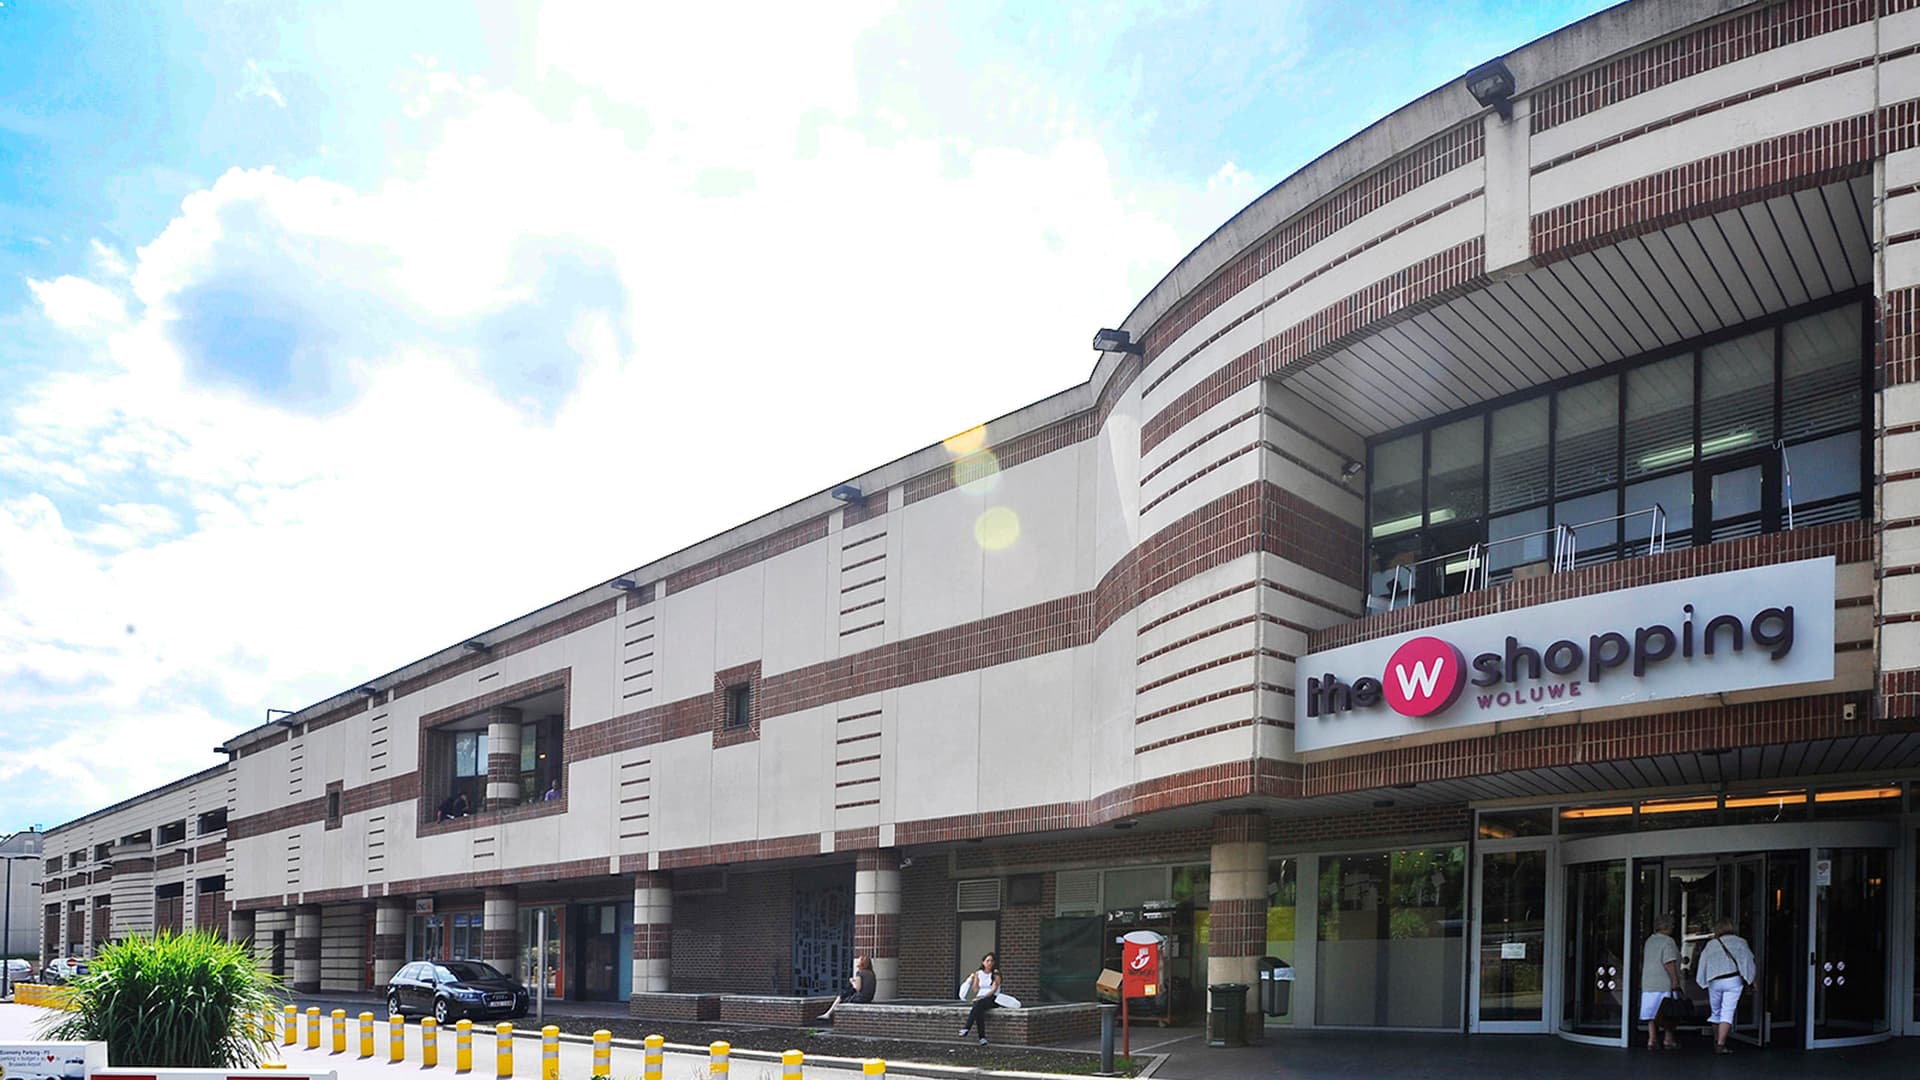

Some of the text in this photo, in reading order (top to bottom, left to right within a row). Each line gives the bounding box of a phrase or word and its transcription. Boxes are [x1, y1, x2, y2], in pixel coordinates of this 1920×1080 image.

[1306, 671, 1384, 718] the
[1471, 602, 1795, 689] shopping
[1477, 679, 1583, 711] WOLUWE
